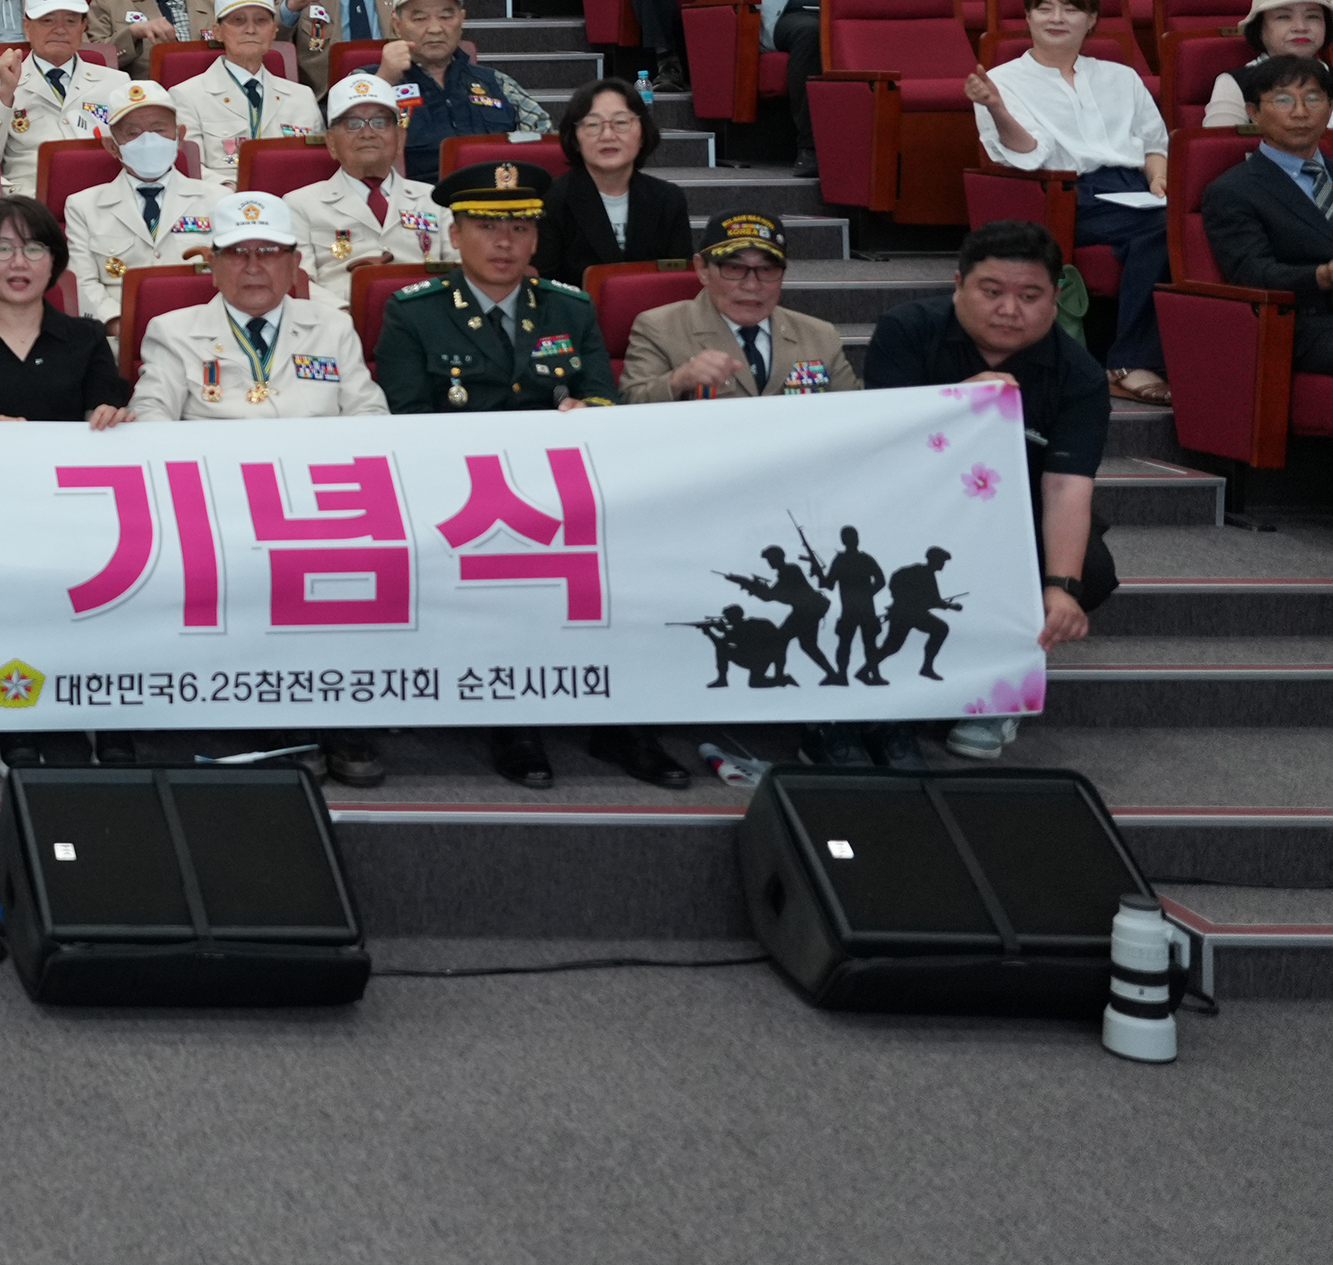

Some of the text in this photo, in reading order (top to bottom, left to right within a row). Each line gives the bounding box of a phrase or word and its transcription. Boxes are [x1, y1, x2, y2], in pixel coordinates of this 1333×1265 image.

[727, 227, 759, 236] KOREA
[55, 447, 603, 628] 기념식
[55, 667, 439, 706] 대한민국6.25참전유공자회
[457, 664, 611, 701] 순천시지회
